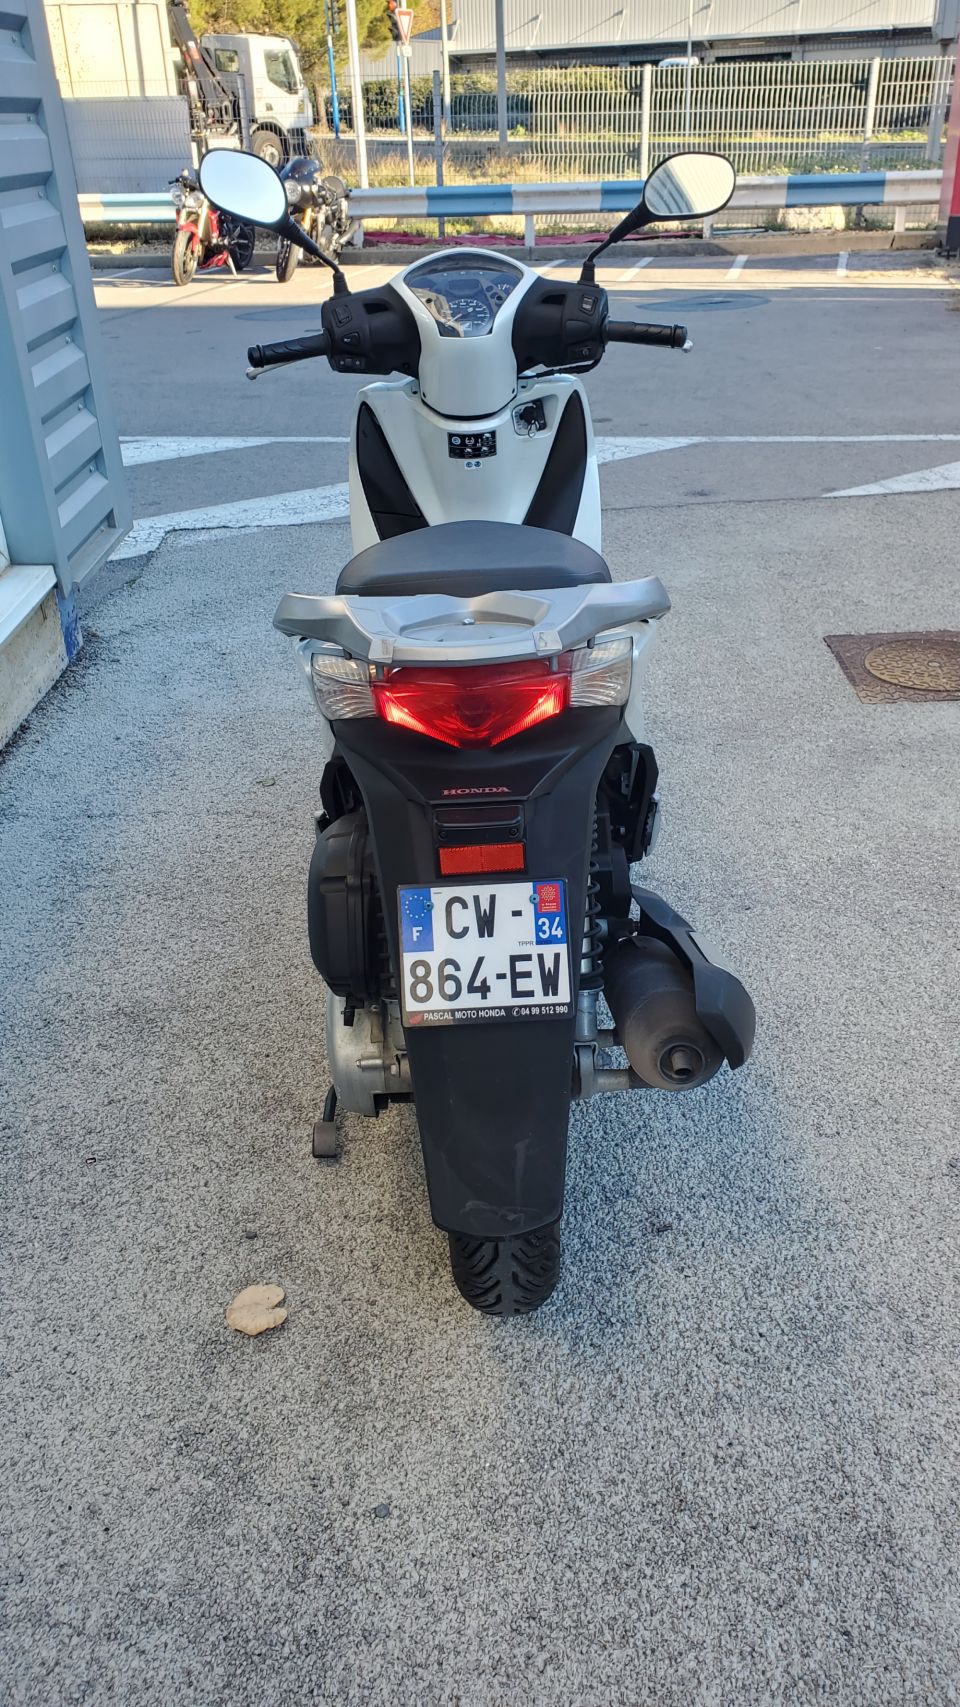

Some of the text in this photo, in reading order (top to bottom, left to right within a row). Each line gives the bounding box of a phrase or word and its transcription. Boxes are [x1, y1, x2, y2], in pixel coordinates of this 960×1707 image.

[442, 786, 512, 796] HONDA
[412, 926, 423, 942] F
[537, 916, 563, 939] 34
[409, 952, 561, 1004] 864-EW
[423, 1005, 568, 1021] PASCAL MOTO HONDA 04 99 512 990
